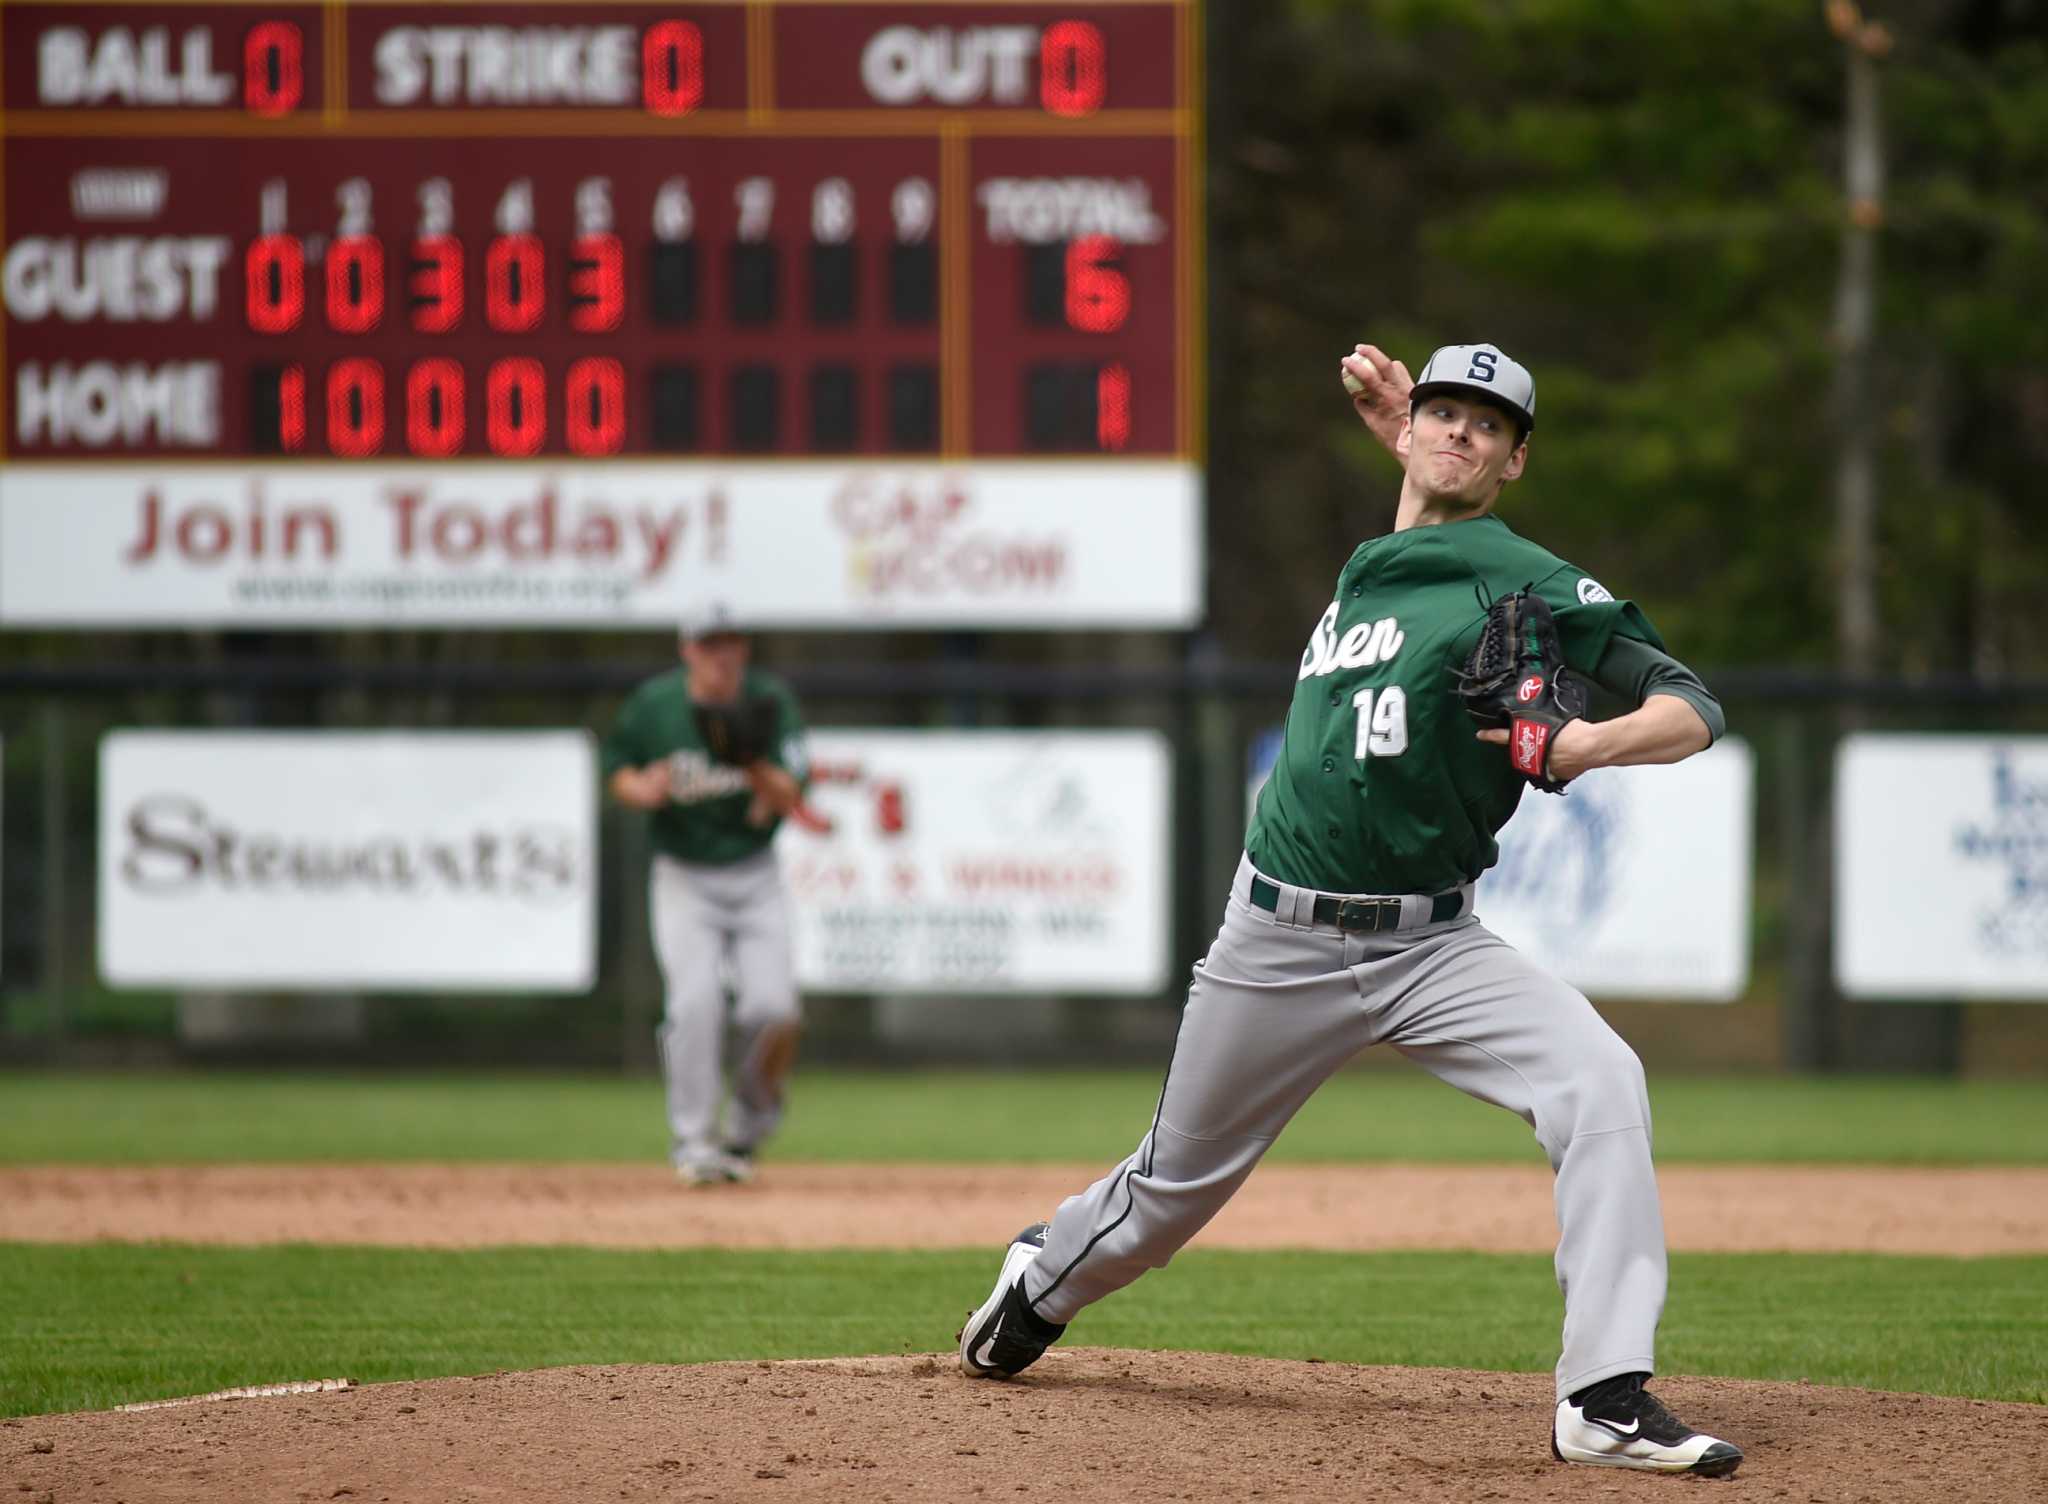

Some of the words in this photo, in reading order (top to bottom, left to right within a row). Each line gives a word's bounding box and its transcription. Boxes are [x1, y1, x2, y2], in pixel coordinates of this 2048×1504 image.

[39, 27, 234, 104] BALL
[244, 21, 303, 118] 0
[374, 27, 635, 104] STRIKE
[642, 20, 704, 118] 0
[861, 26, 1038, 103] OUT
[1041, 20, 1106, 118] 0
[260, 178, 287, 236] 1
[336, 176, 373, 242] 2
[416, 177, 453, 242] 3
[497, 177, 533, 237] 4
[575, 176, 612, 240] 5
[653, 176, 693, 242] 6
[734, 176, 775, 242] 7
[811, 177, 855, 243] 8
[892, 177, 934, 243] 9
[977, 176, 1164, 243] TOTAL
[2, 235, 229, 320] GUEST
[246, 234, 304, 333] 0
[327, 234, 384, 333] 0
[410, 234, 464, 333] 3
[486, 234, 545, 333] 0
[570, 234, 624, 333] 3
[1065, 234, 1131, 333] 6
[17, 362, 221, 446] HOME
[280, 360, 304, 453] 1
[326, 357, 385, 457] 0
[407, 357, 465, 457] 0
[487, 357, 546, 457] 0
[566, 357, 625, 457] 0
[1096, 362, 1131, 451] 1
[1467, 351, 1498, 383] S
[125, 478, 338, 565] Join
[382, 478, 728, 578] Today!
[1352, 685, 1409, 760] 19
